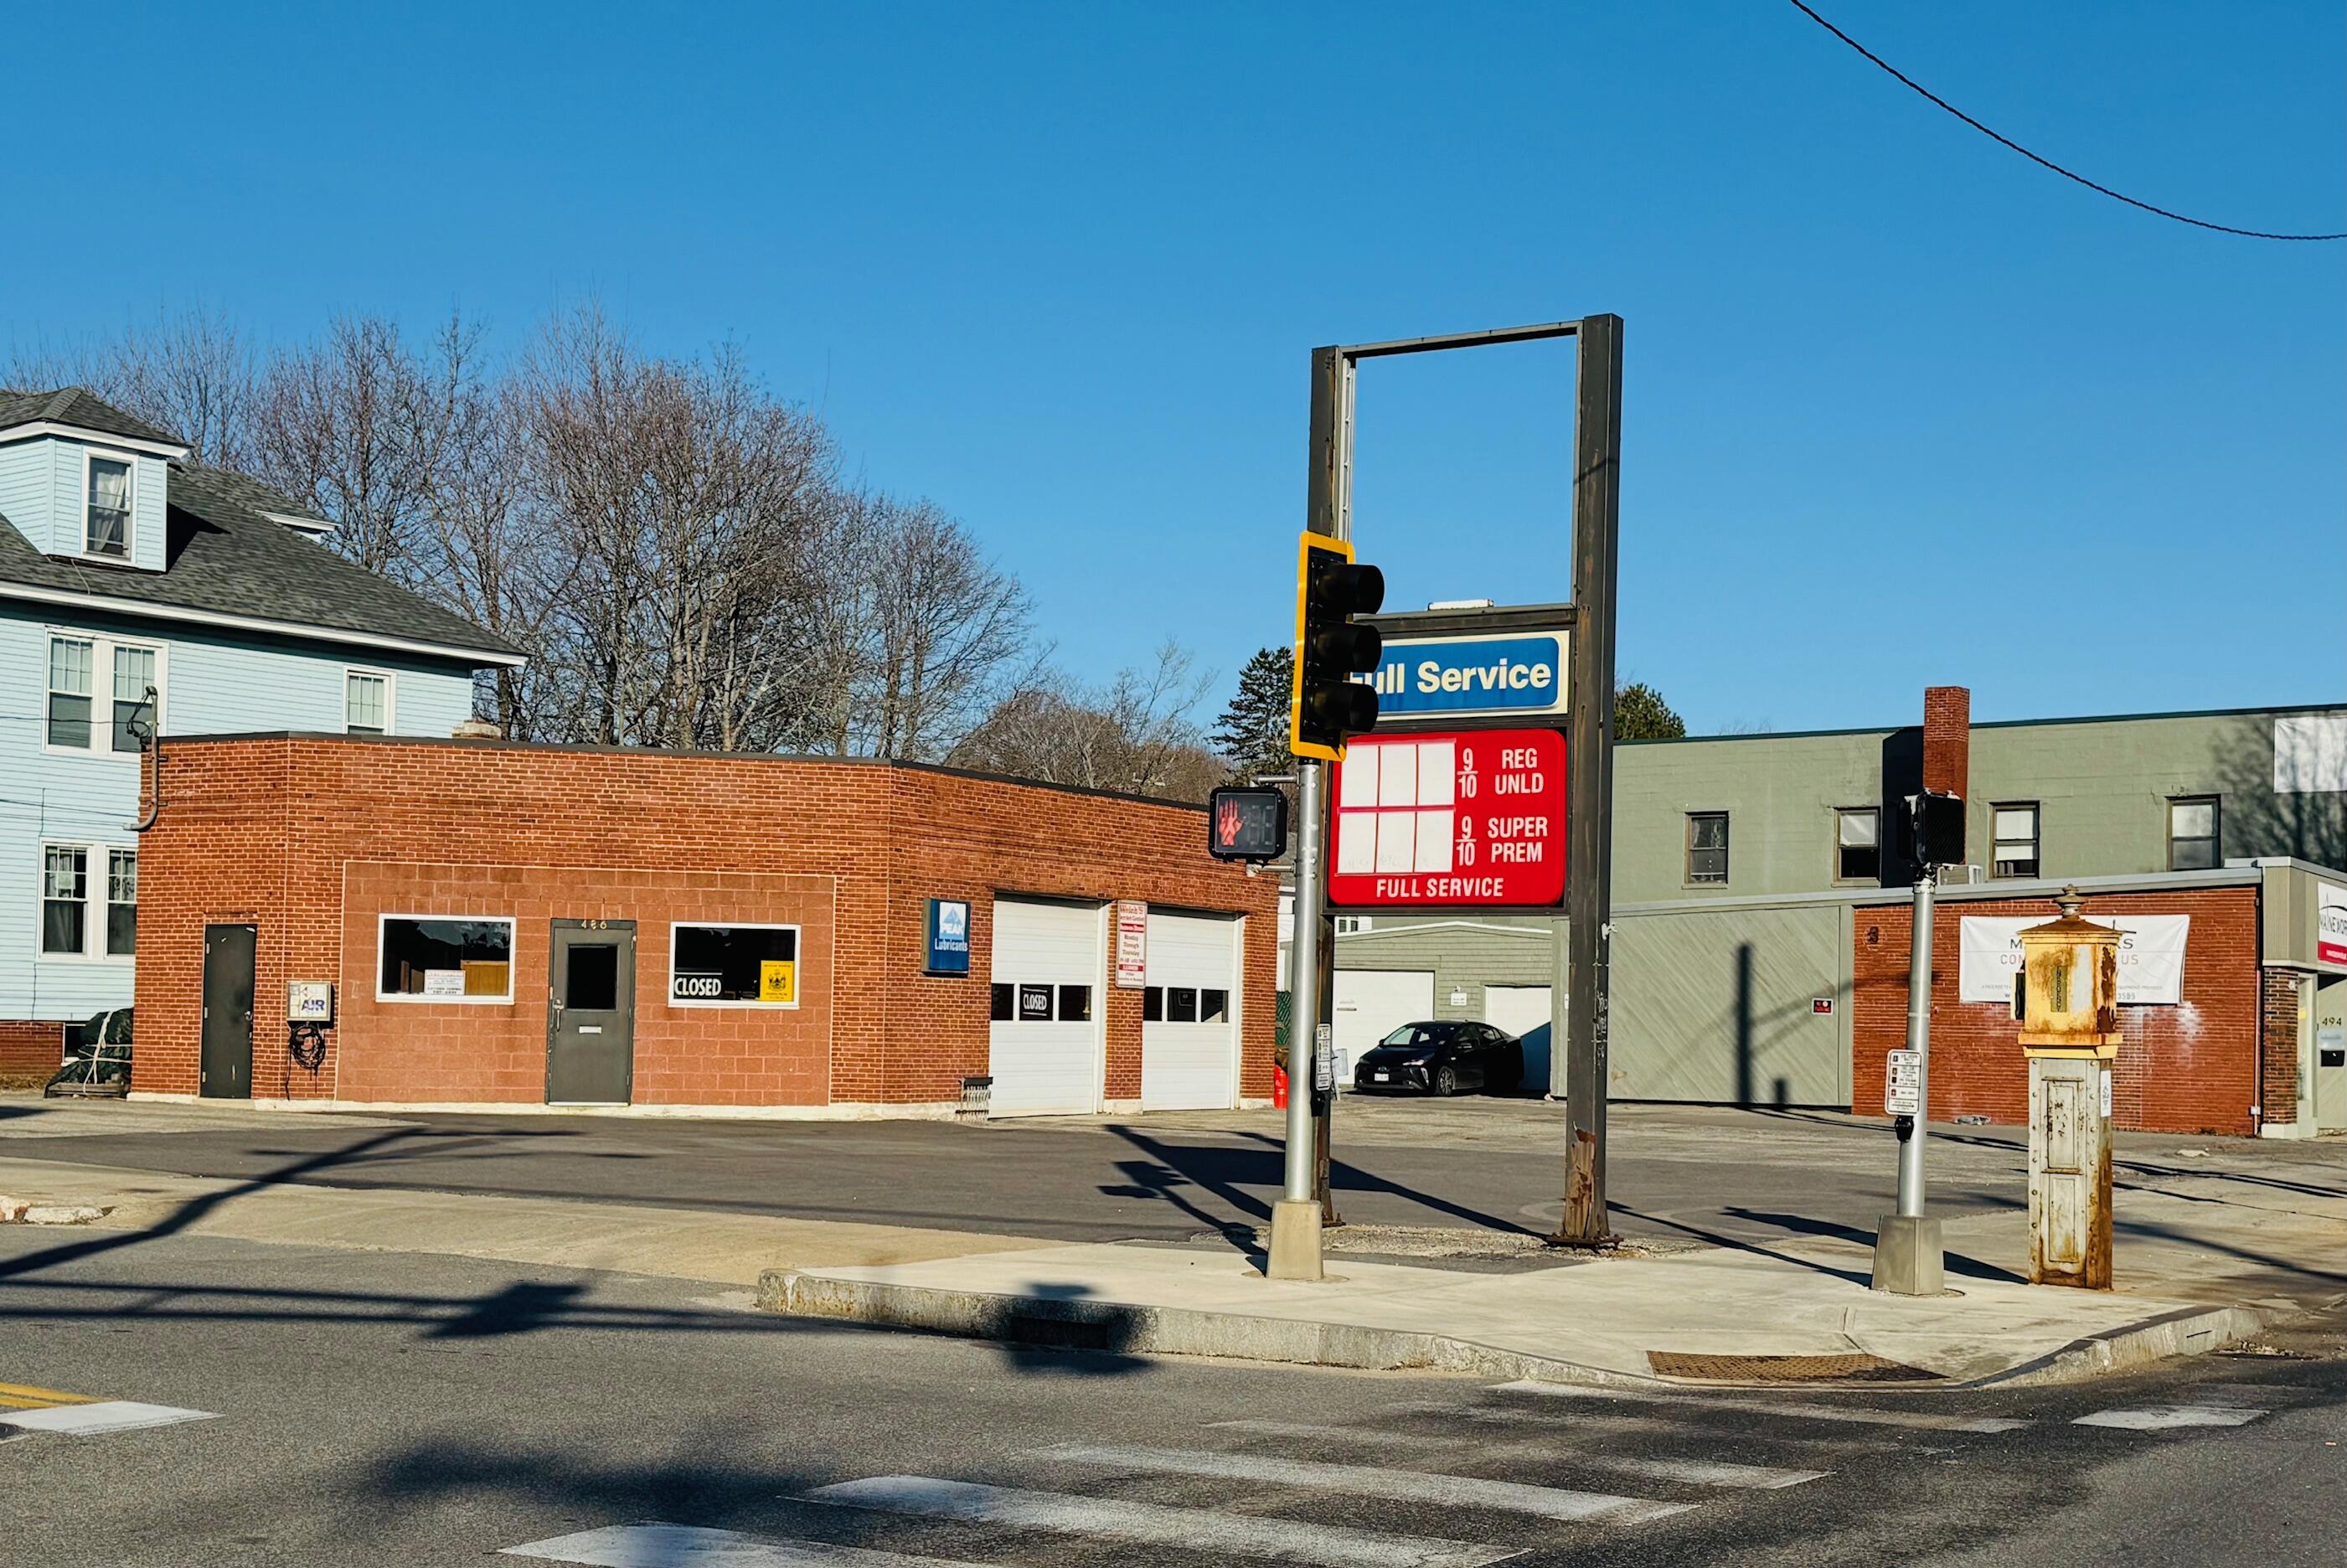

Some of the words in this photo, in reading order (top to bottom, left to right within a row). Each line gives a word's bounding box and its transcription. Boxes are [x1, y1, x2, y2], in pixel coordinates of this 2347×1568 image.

[1416, 658, 1551, 694] Service
[1462, 747, 1474, 771] 9
[1501, 748, 1538, 769] REG
[1457, 774, 1478, 798] 10
[1494, 772, 1545, 795] UNLD
[1461, 816, 1473, 839] 9
[1487, 816, 1548, 838] SUPER
[1456, 842, 1476, 866] 10
[1491, 842, 1543, 864] PREM
[1376, 879, 1421, 898] FULL
[1426, 877, 1504, 898] SERVICE
[934, 938, 968, 952] Lubricants
[2121, 954, 2138, 965] US
[674, 977, 722, 996] CLOSED
[302, 999, 325, 1011] AIR
[1023, 993, 1047, 1010] CLOSED
[2321, 1017, 2342, 1026] 494
